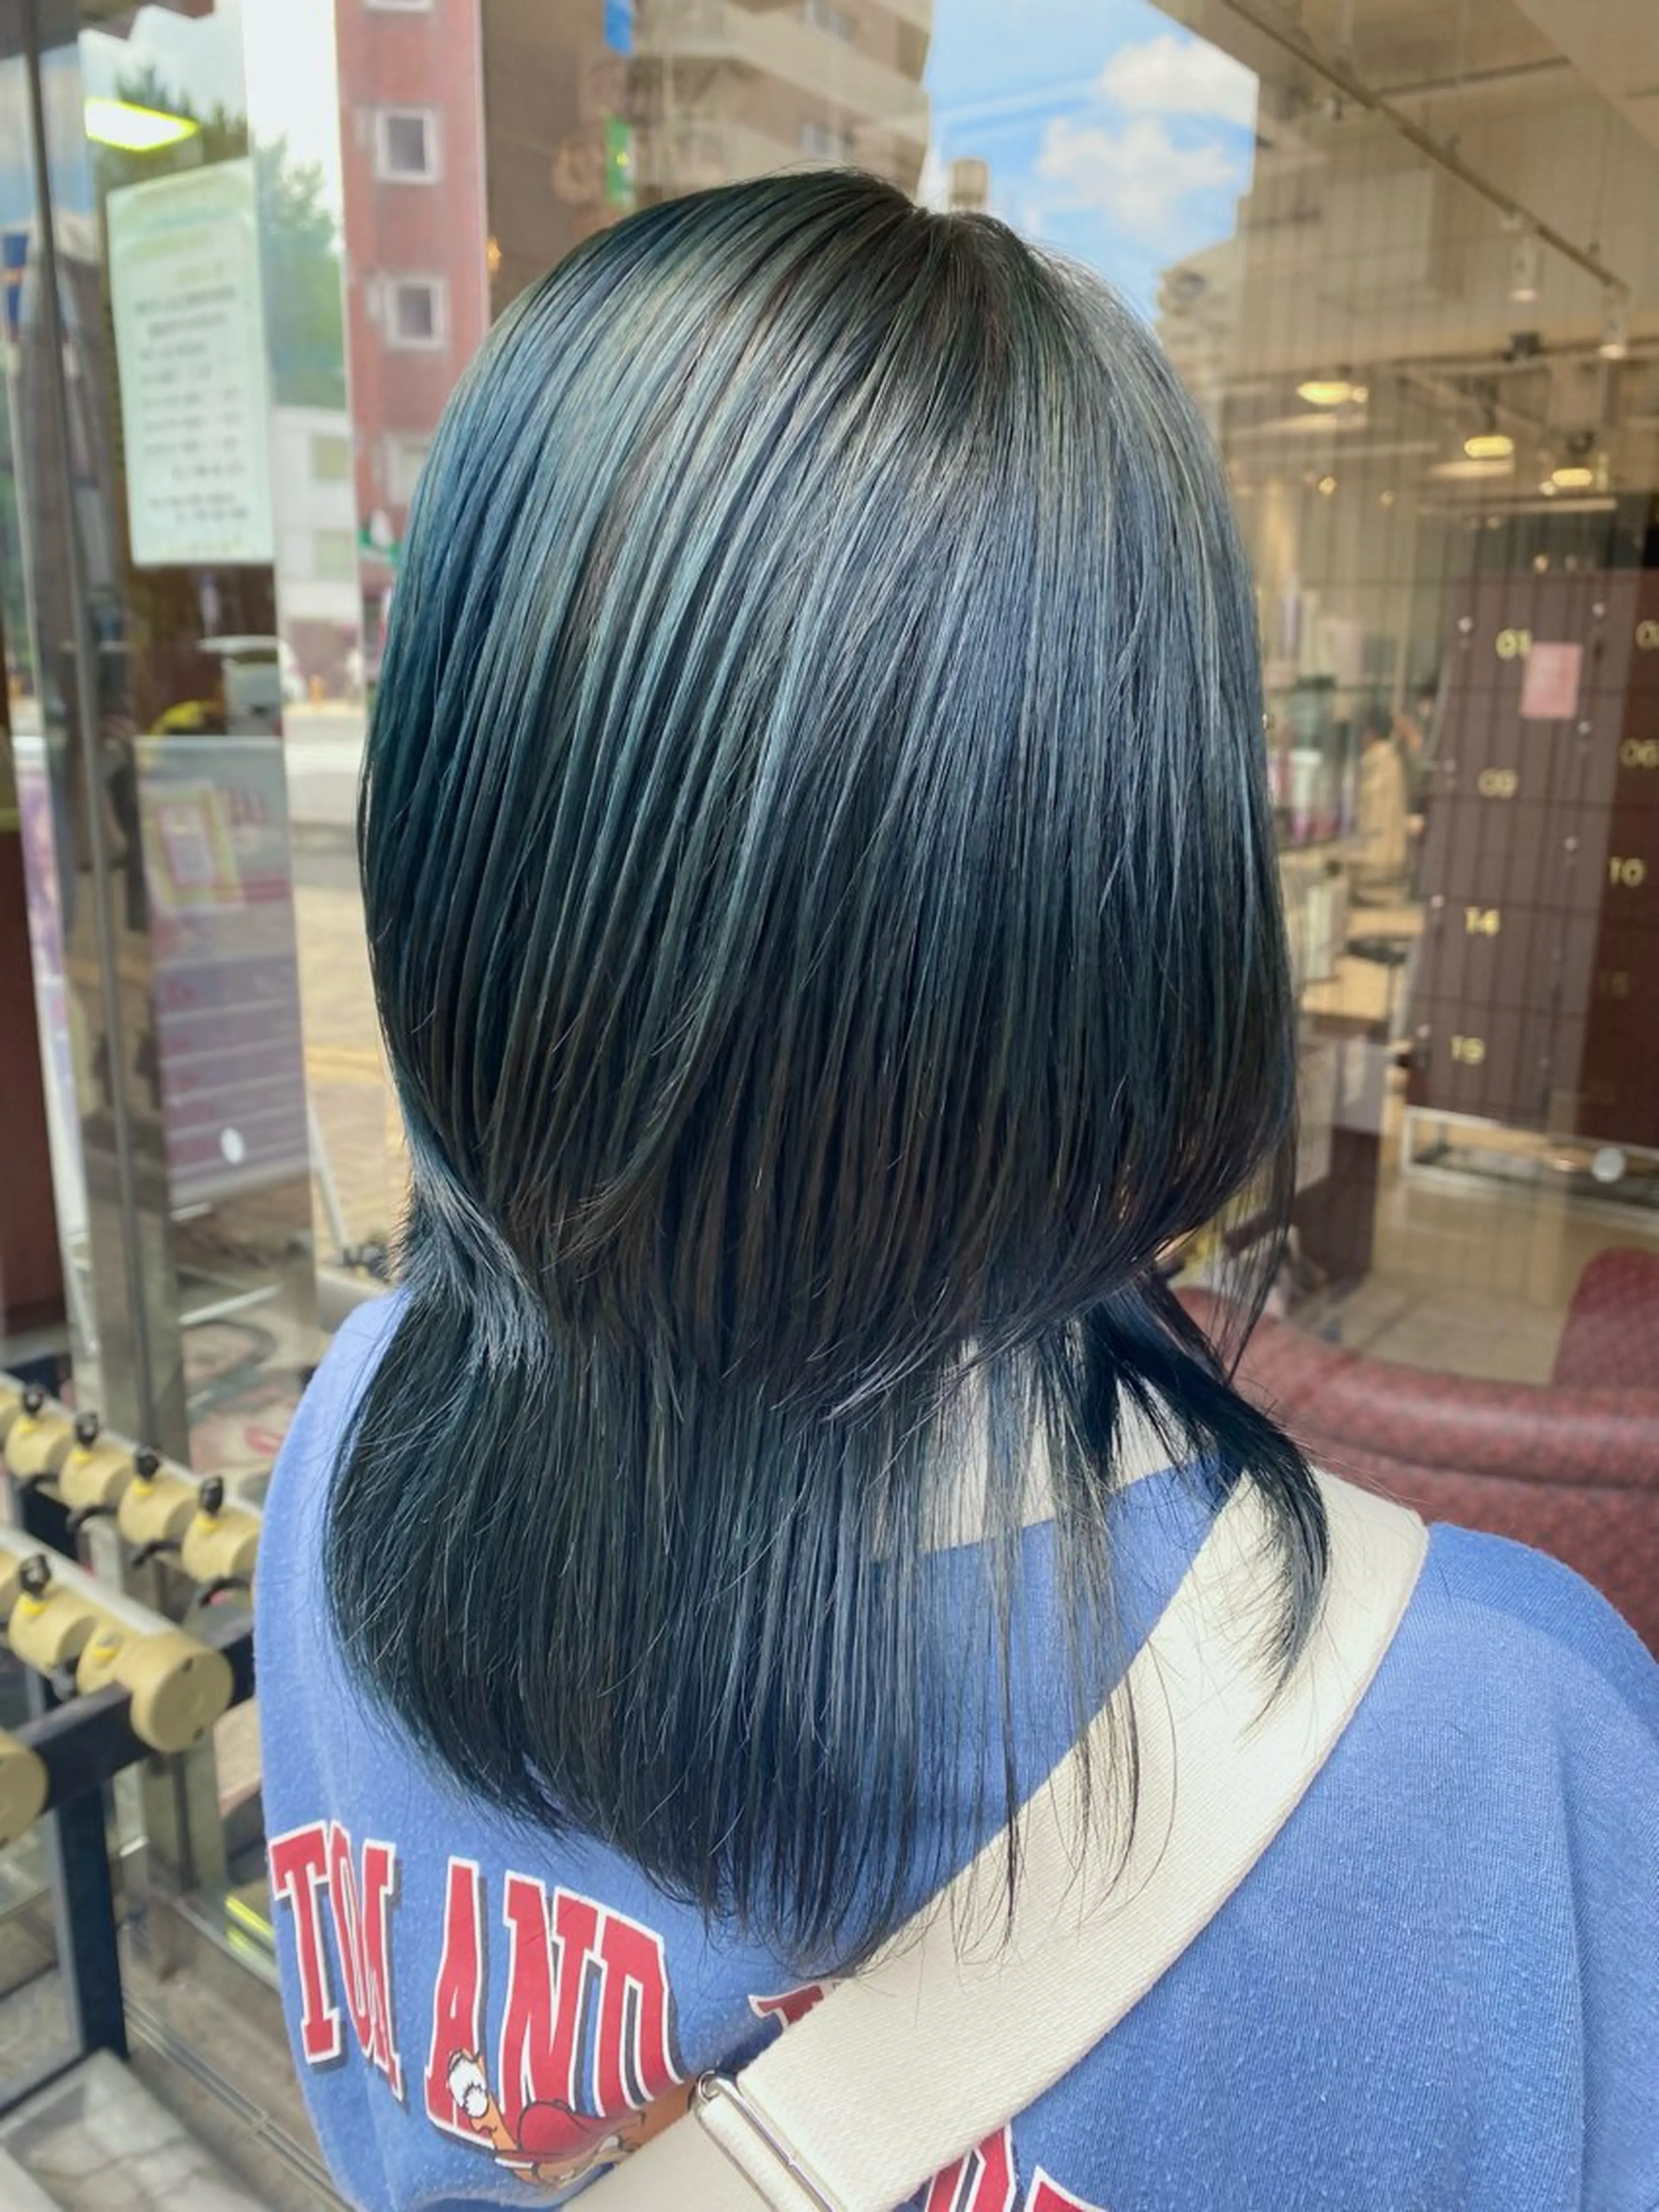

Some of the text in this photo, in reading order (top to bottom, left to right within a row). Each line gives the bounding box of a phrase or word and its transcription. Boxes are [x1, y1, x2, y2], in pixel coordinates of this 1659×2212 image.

[1610, 856, 1644, 887] 10
[1465, 906, 1500, 937] 14
[423, 1856, 685, 2147] AND
